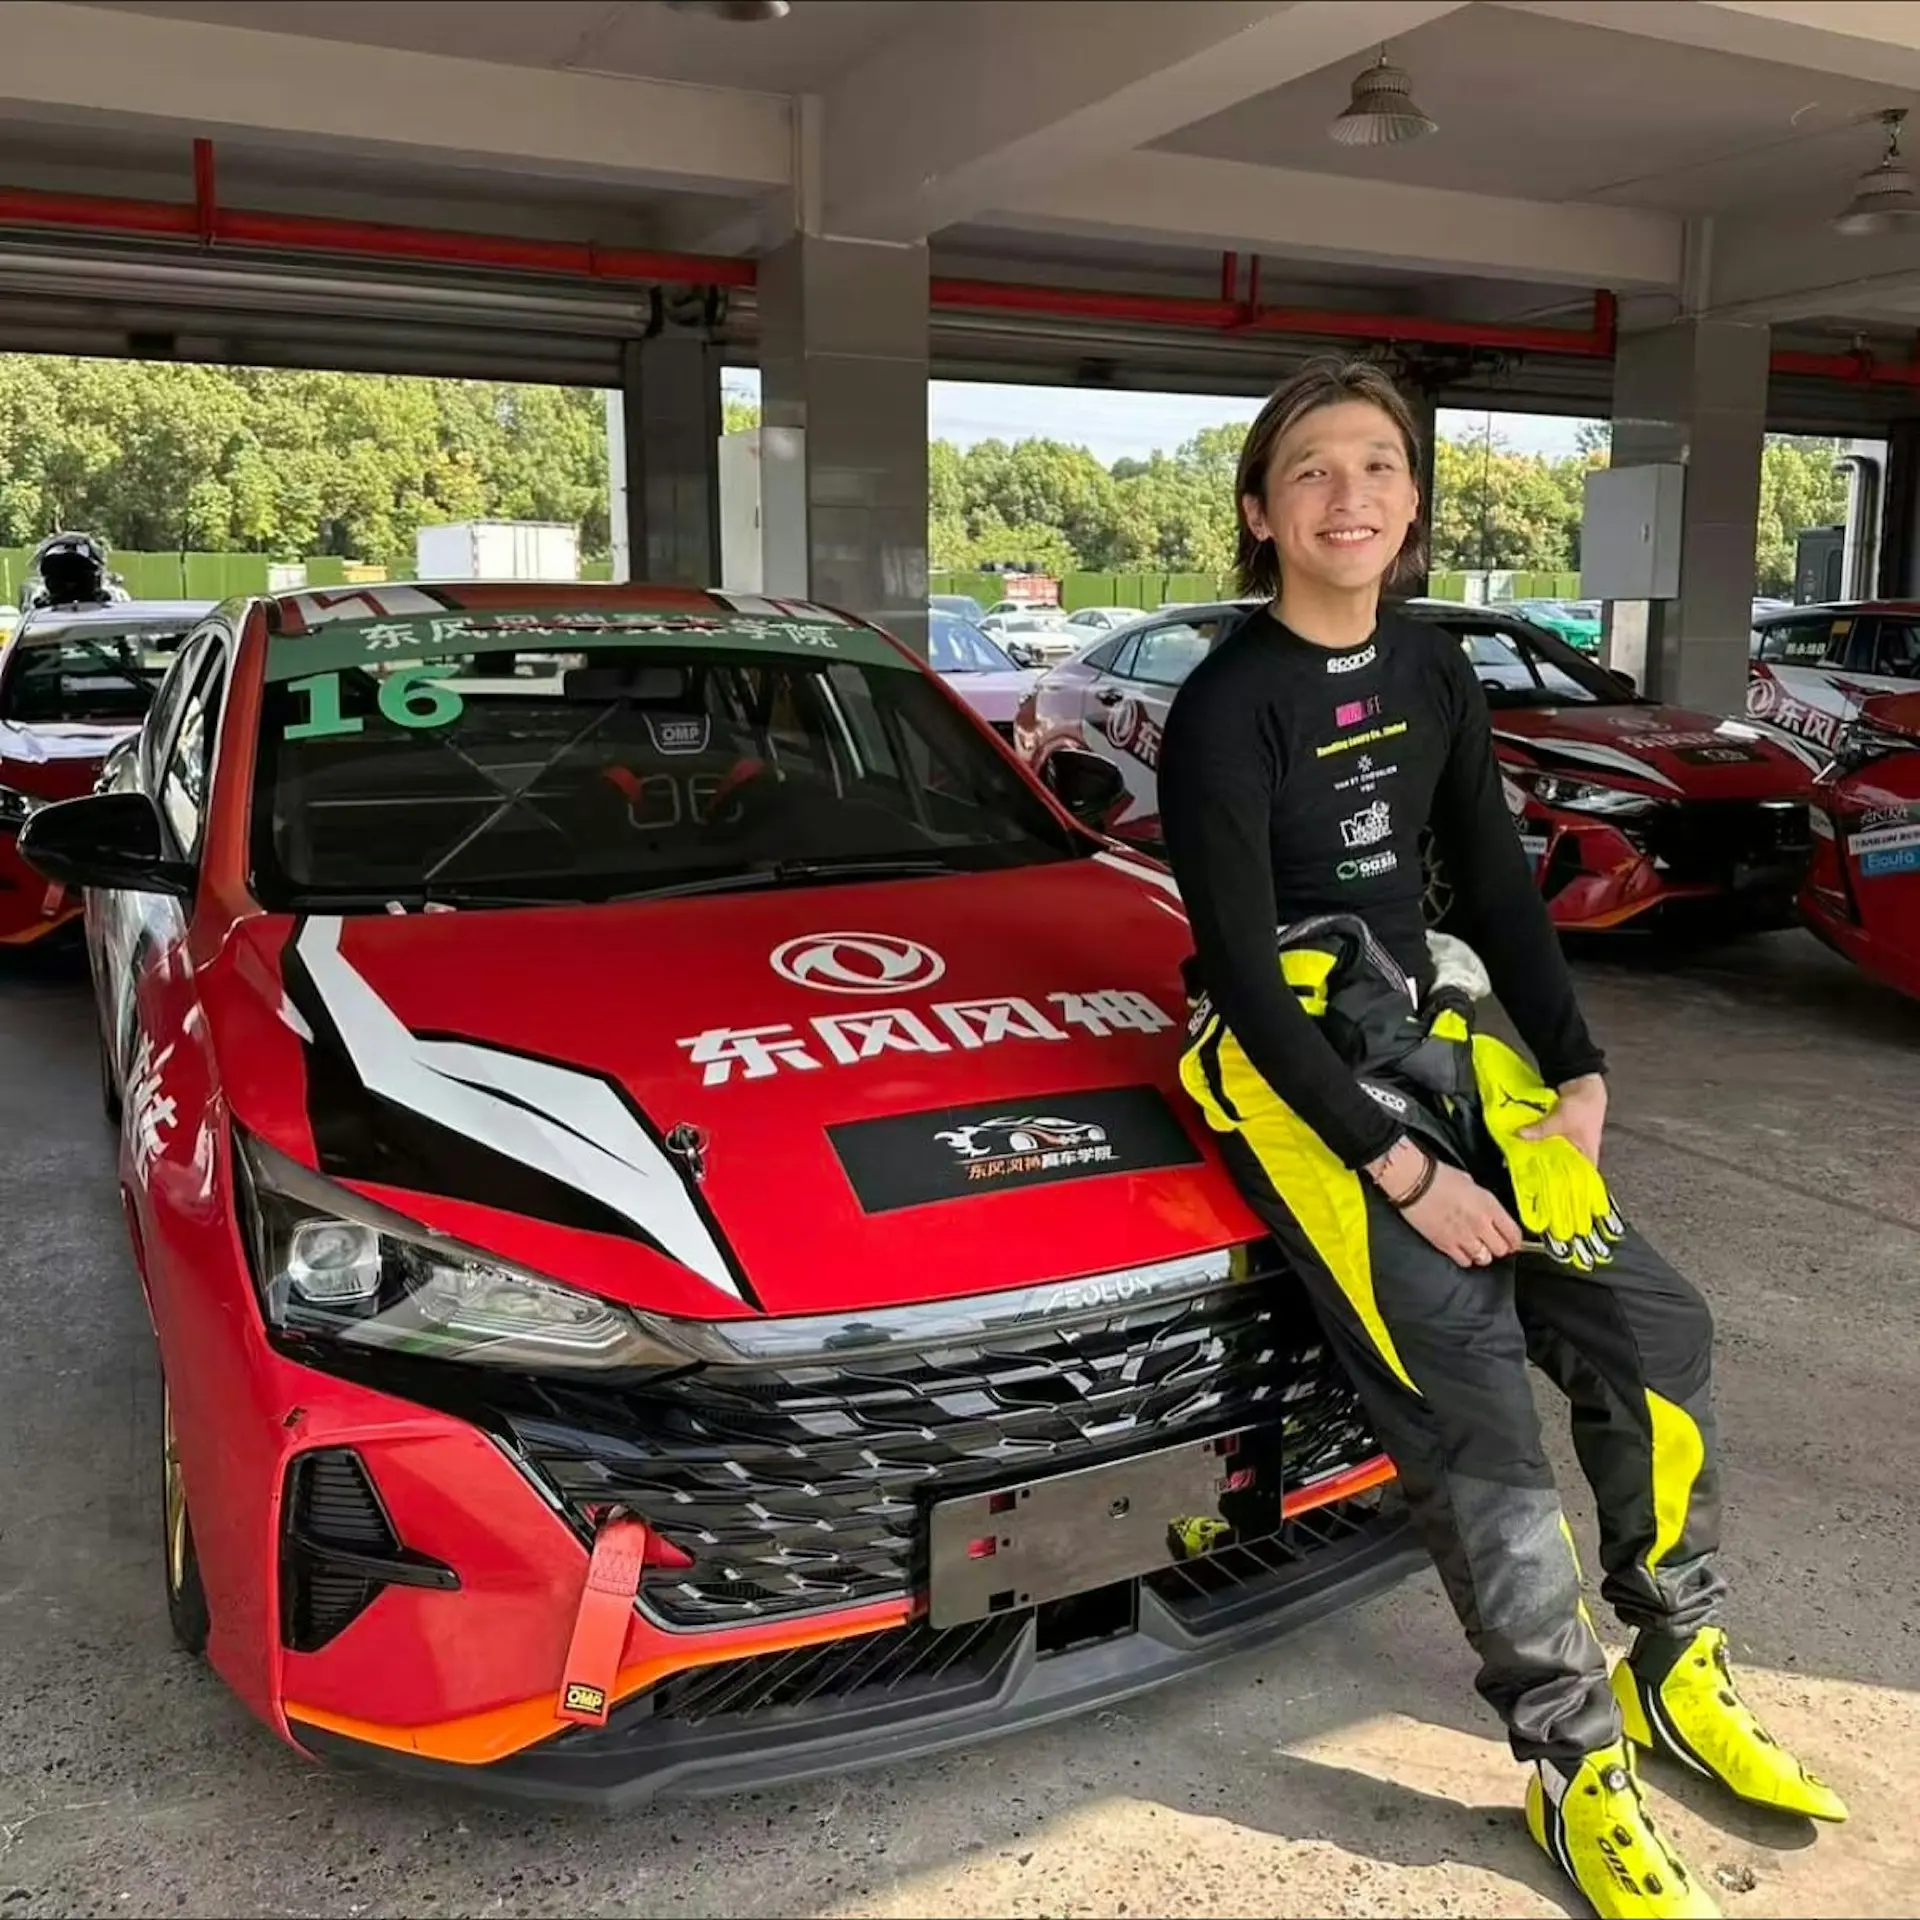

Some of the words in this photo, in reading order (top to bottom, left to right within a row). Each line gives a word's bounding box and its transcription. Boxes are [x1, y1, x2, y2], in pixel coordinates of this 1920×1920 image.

[284, 665, 464, 740] 16
[661, 726, 700, 741] OMP
[676, 988, 1177, 1087] 东风风神
[567, 1690, 603, 1708] OMP
